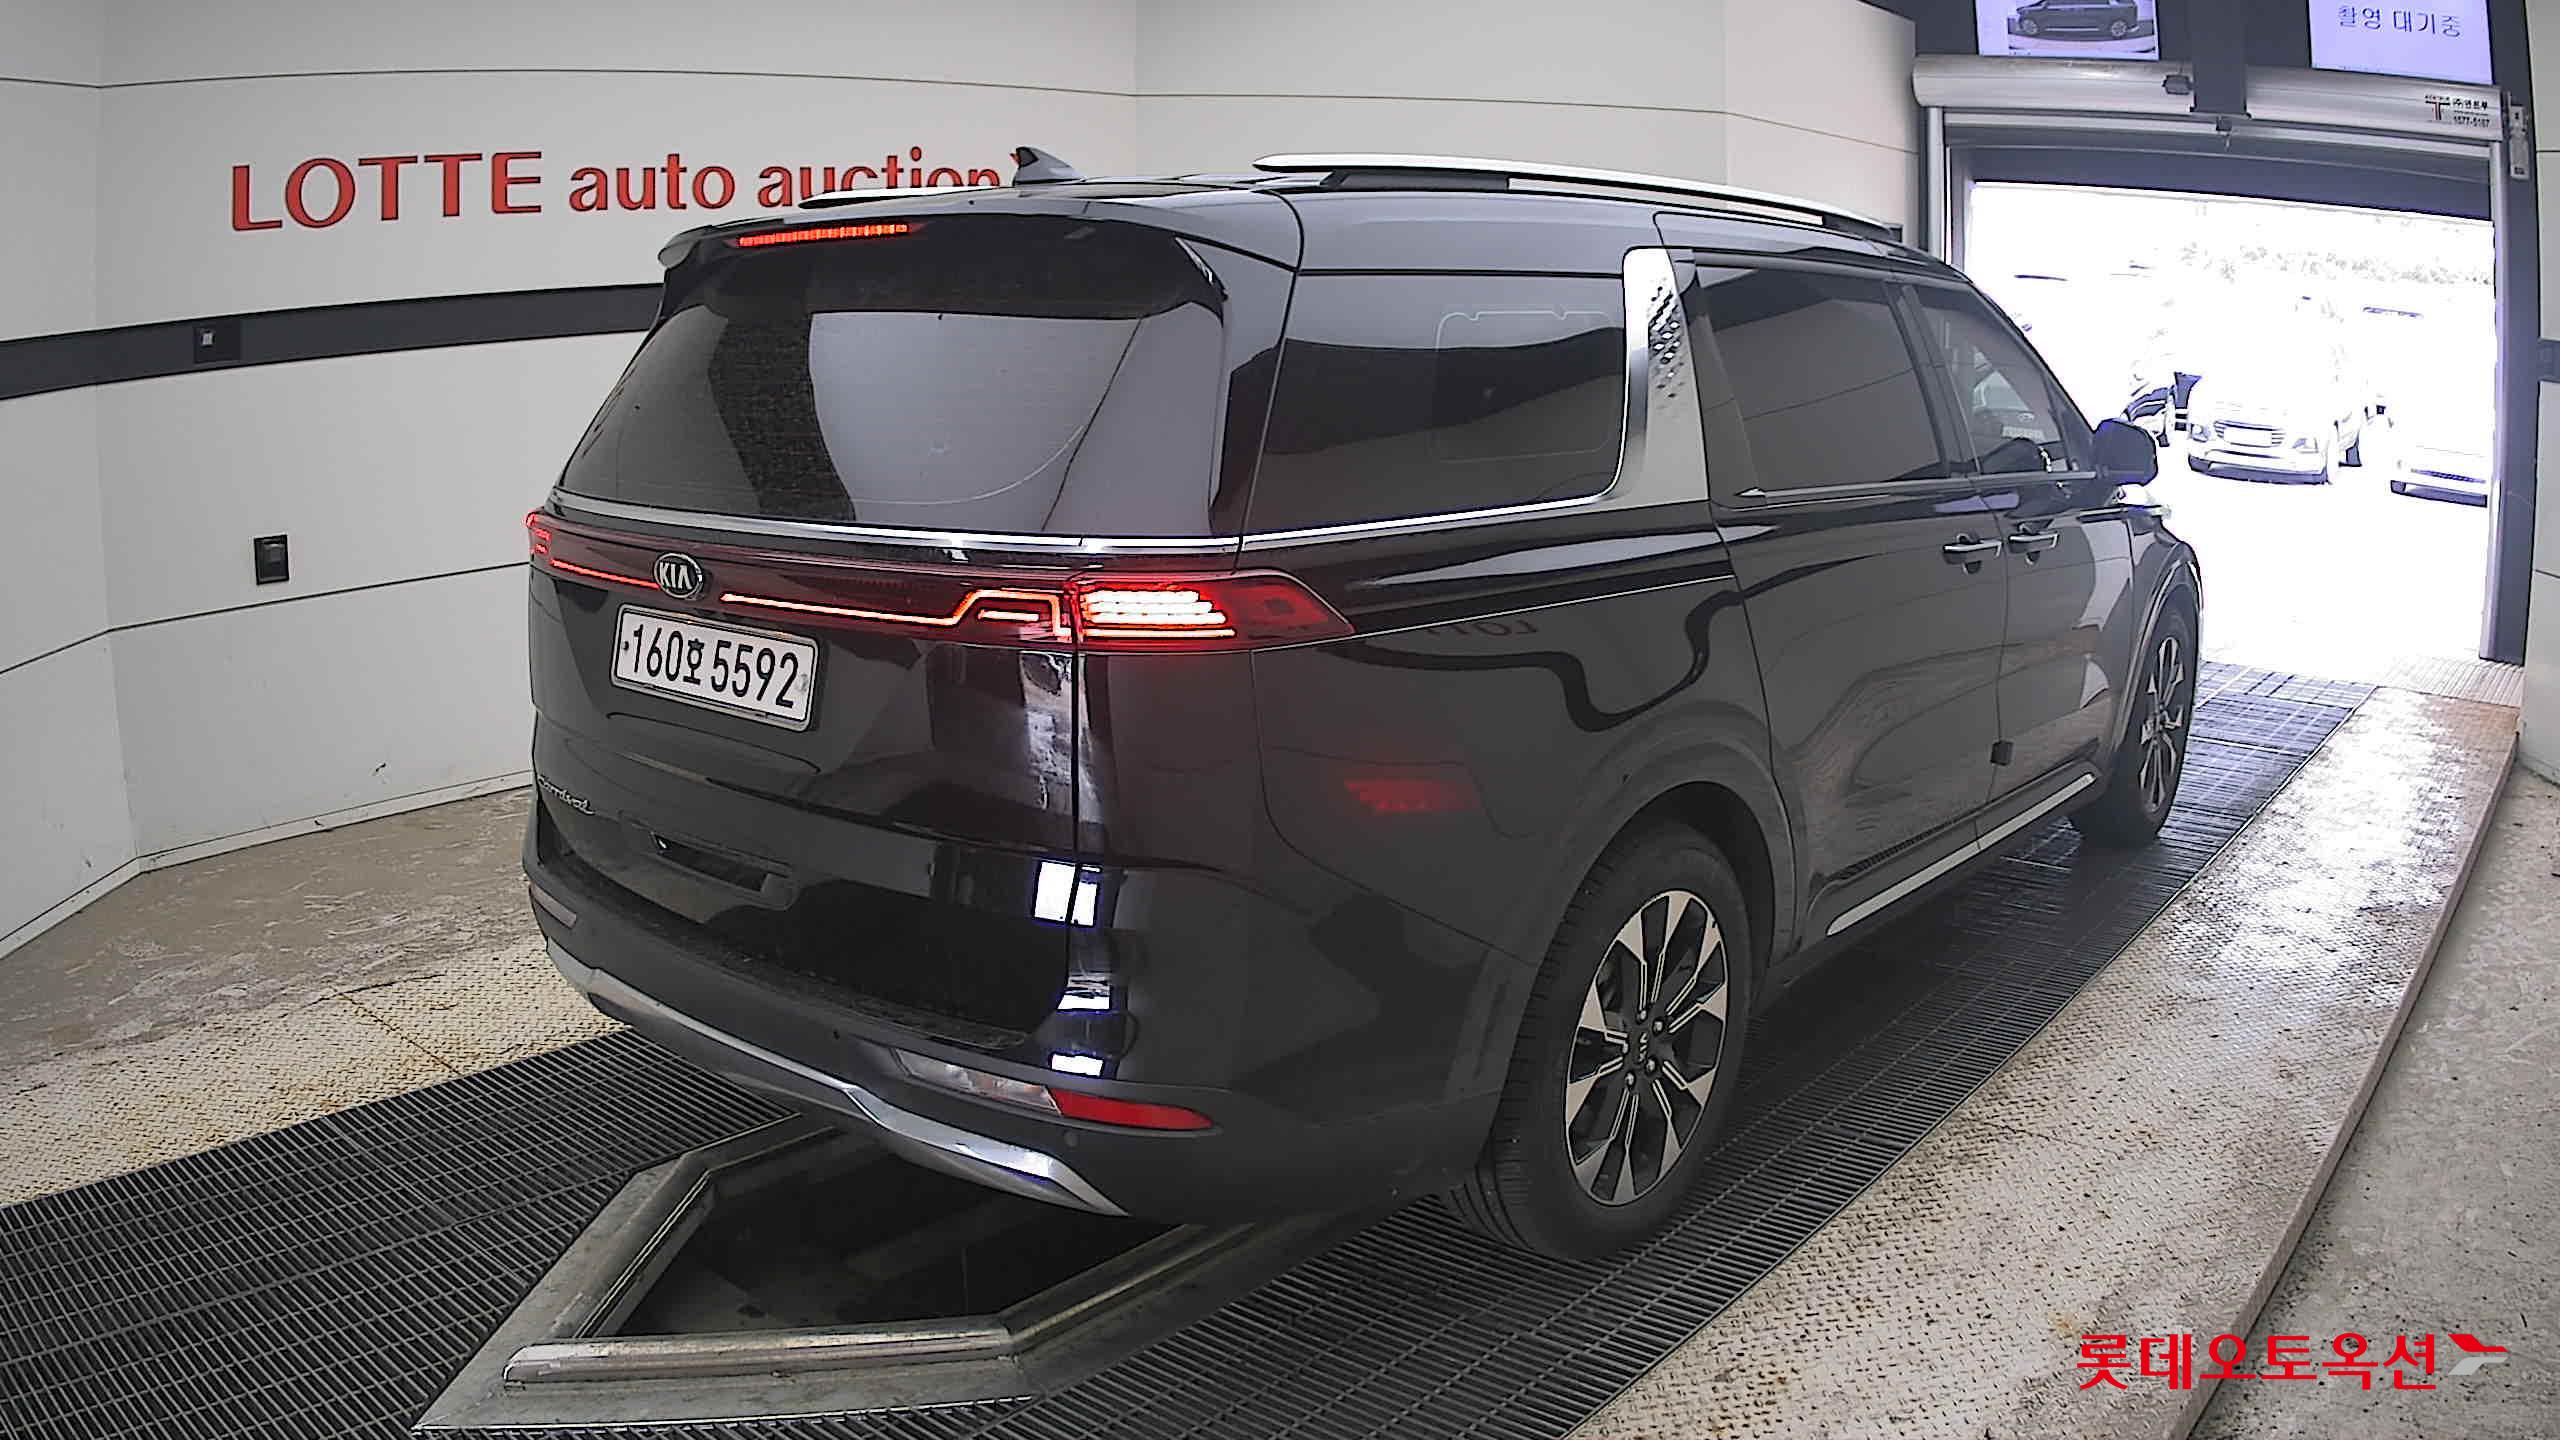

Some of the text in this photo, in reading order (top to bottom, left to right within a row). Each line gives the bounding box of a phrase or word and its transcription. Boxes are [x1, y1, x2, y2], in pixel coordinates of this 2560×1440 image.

[2338, 5, 2461, 38] 촬영 대기중
[232, 146, 1001, 232] LOTTE auto auction
[659, 561, 693, 590] KIA
